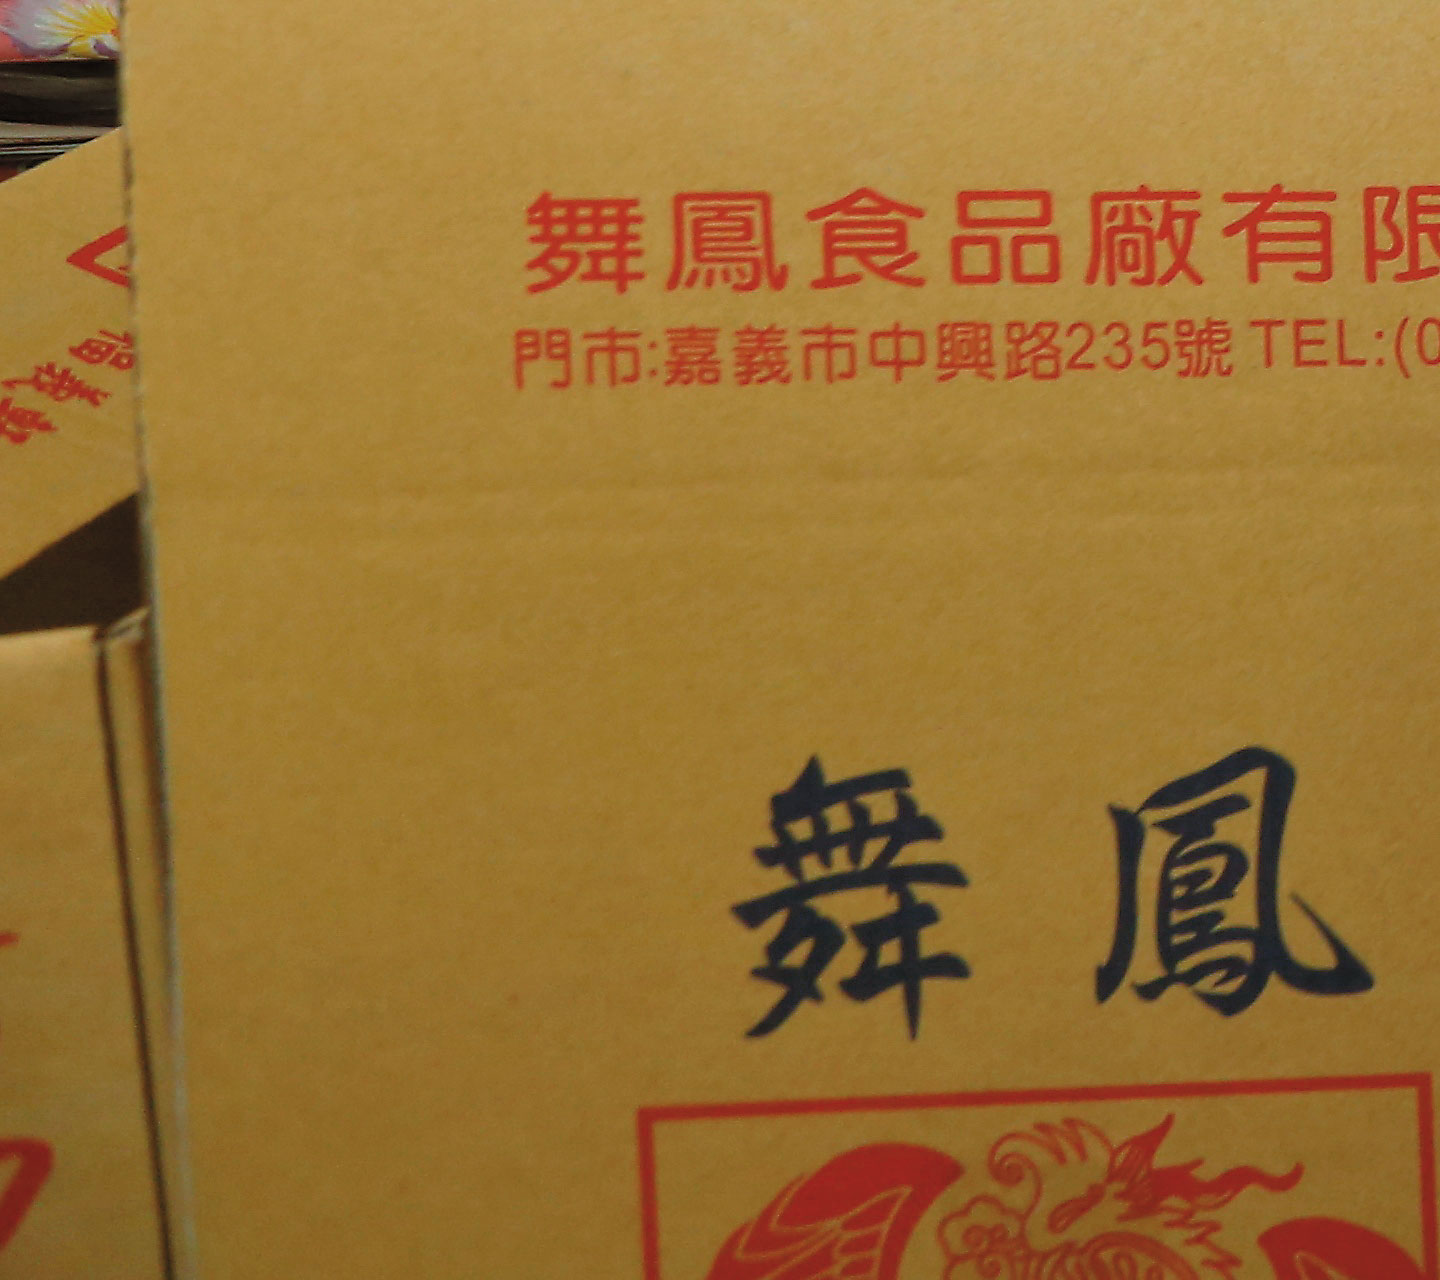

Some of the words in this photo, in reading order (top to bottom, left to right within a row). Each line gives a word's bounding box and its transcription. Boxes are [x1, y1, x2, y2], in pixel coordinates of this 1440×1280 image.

[510, 317, 1234, 392] 門市:嘉義市中興路235號
[730, 745, 1376, 1042] 舞鳳
